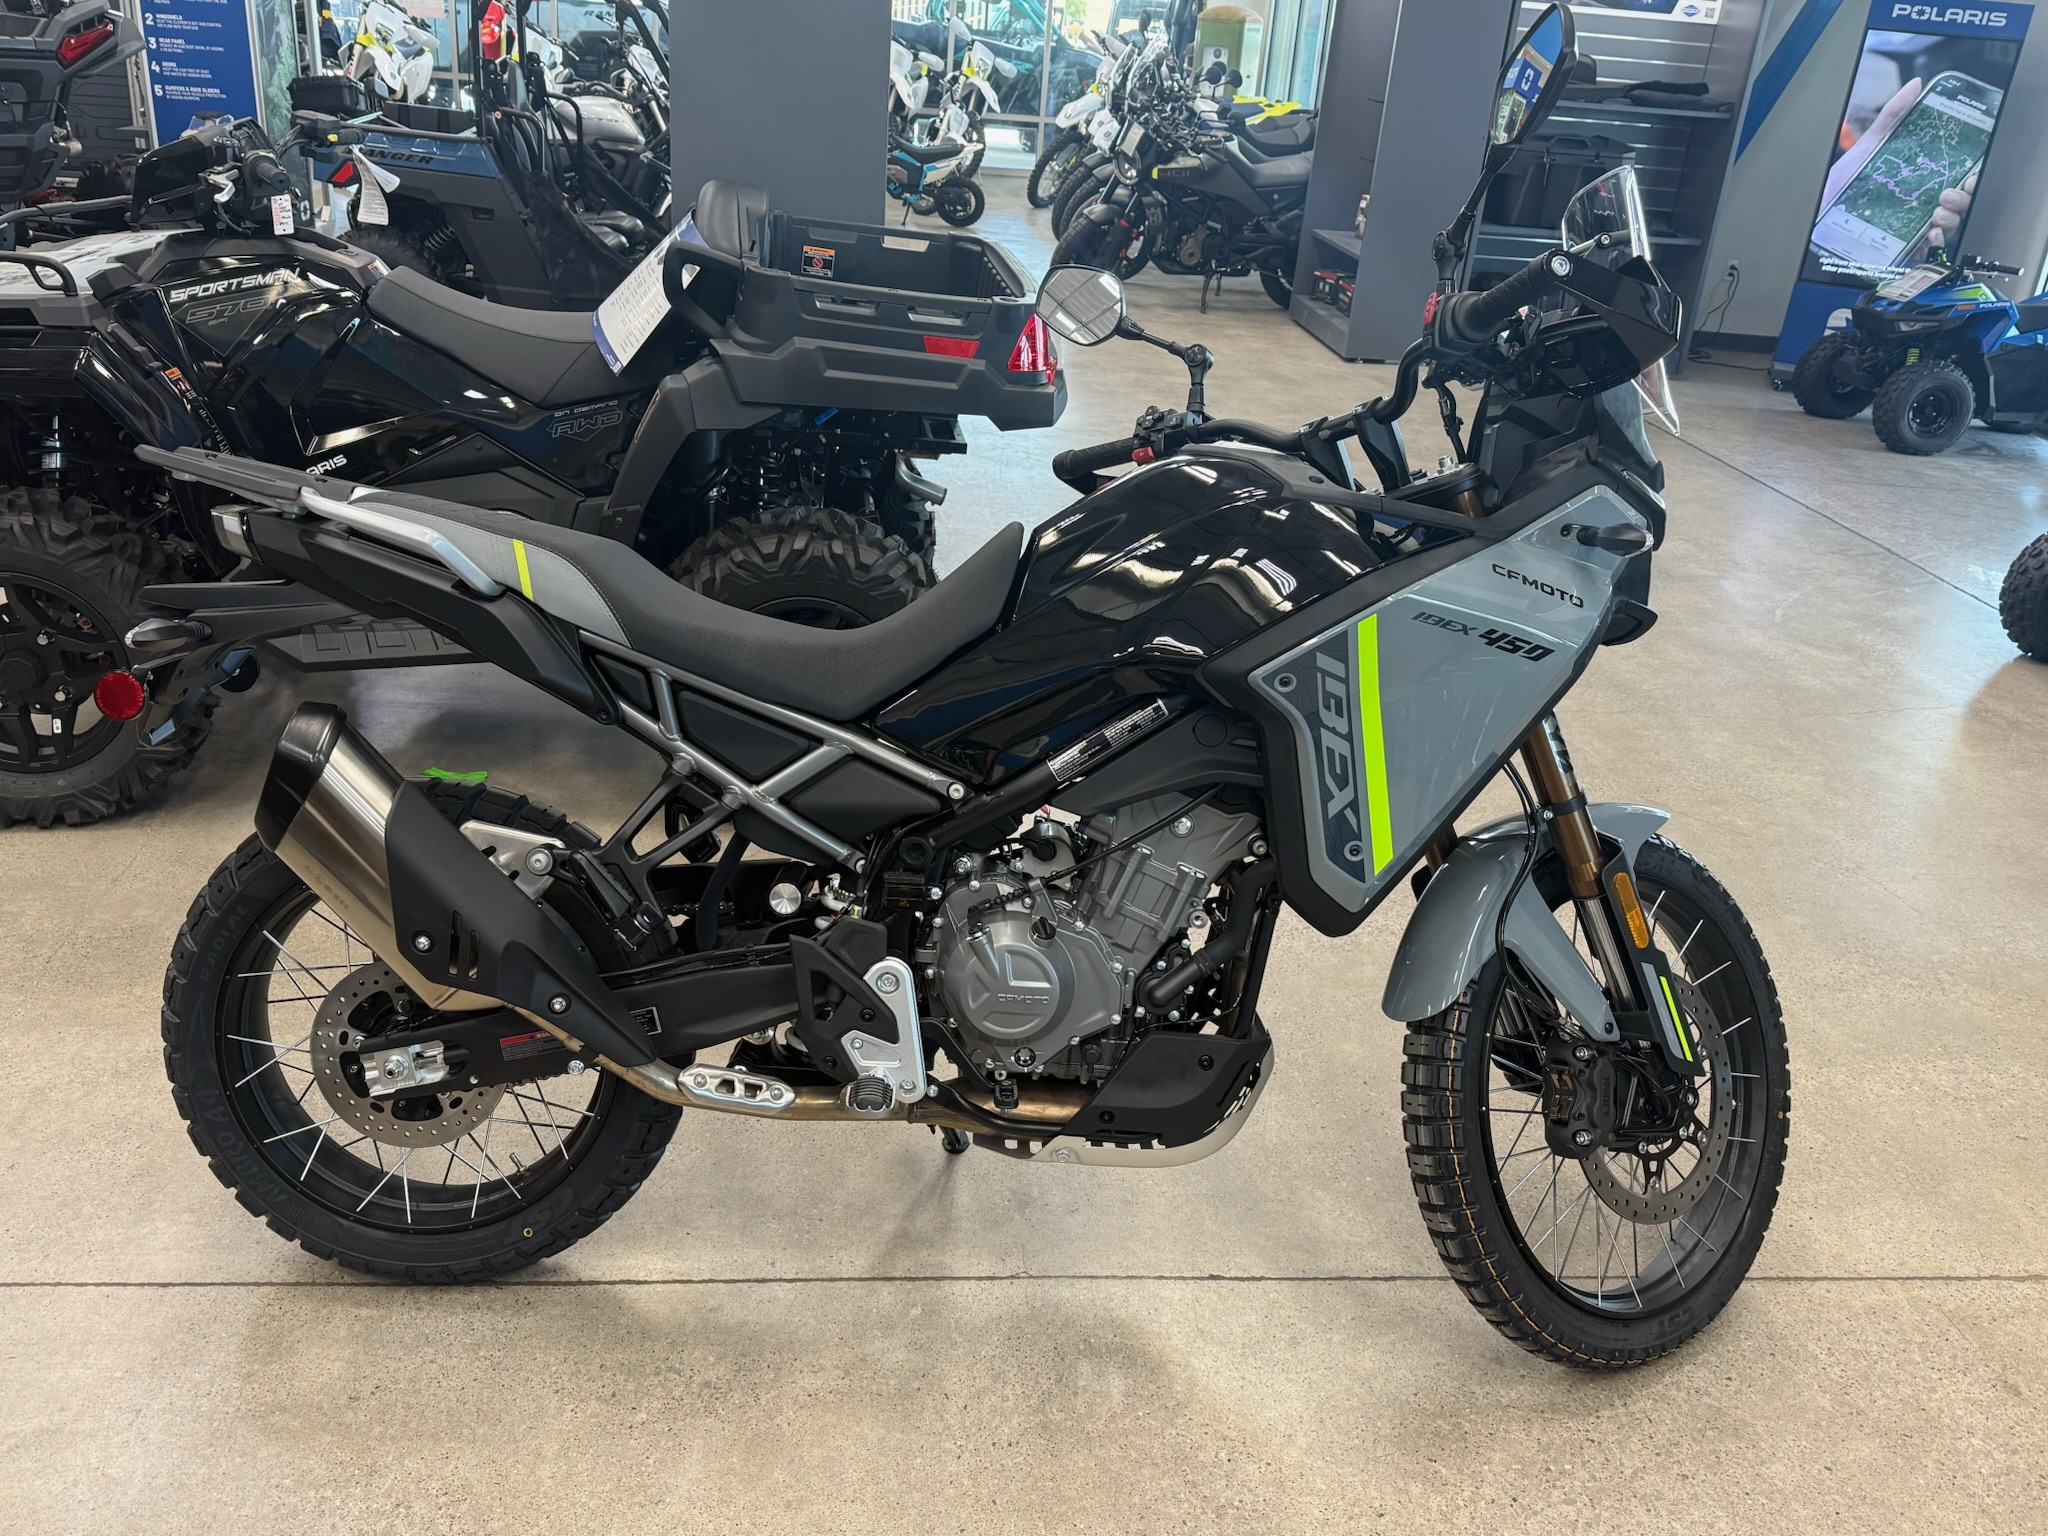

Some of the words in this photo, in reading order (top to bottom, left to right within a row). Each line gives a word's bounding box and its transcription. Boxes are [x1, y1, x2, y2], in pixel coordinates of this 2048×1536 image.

[145, 13, 154, 25] 2
[1891, 3, 2008, 27] POLARIS
[147, 36, 157, 49] 3
[151, 60, 160, 73] 4
[154, 84, 163, 96] 5
[169, 267, 301, 303] SPORTSMAN
[186, 295, 271, 324] 570
[573, 400, 619, 413] DEMAND
[552, 410, 623, 438] AWD
[306, 454, 347, 475] ARIS
[1491, 563, 1584, 609] CFMOTO
[1411, 611, 1479, 636] IBEX
[1478, 628, 1556, 662] 450
[1316, 651, 1358, 834] IBEX
[997, 993, 1050, 1004] CFMOTO
